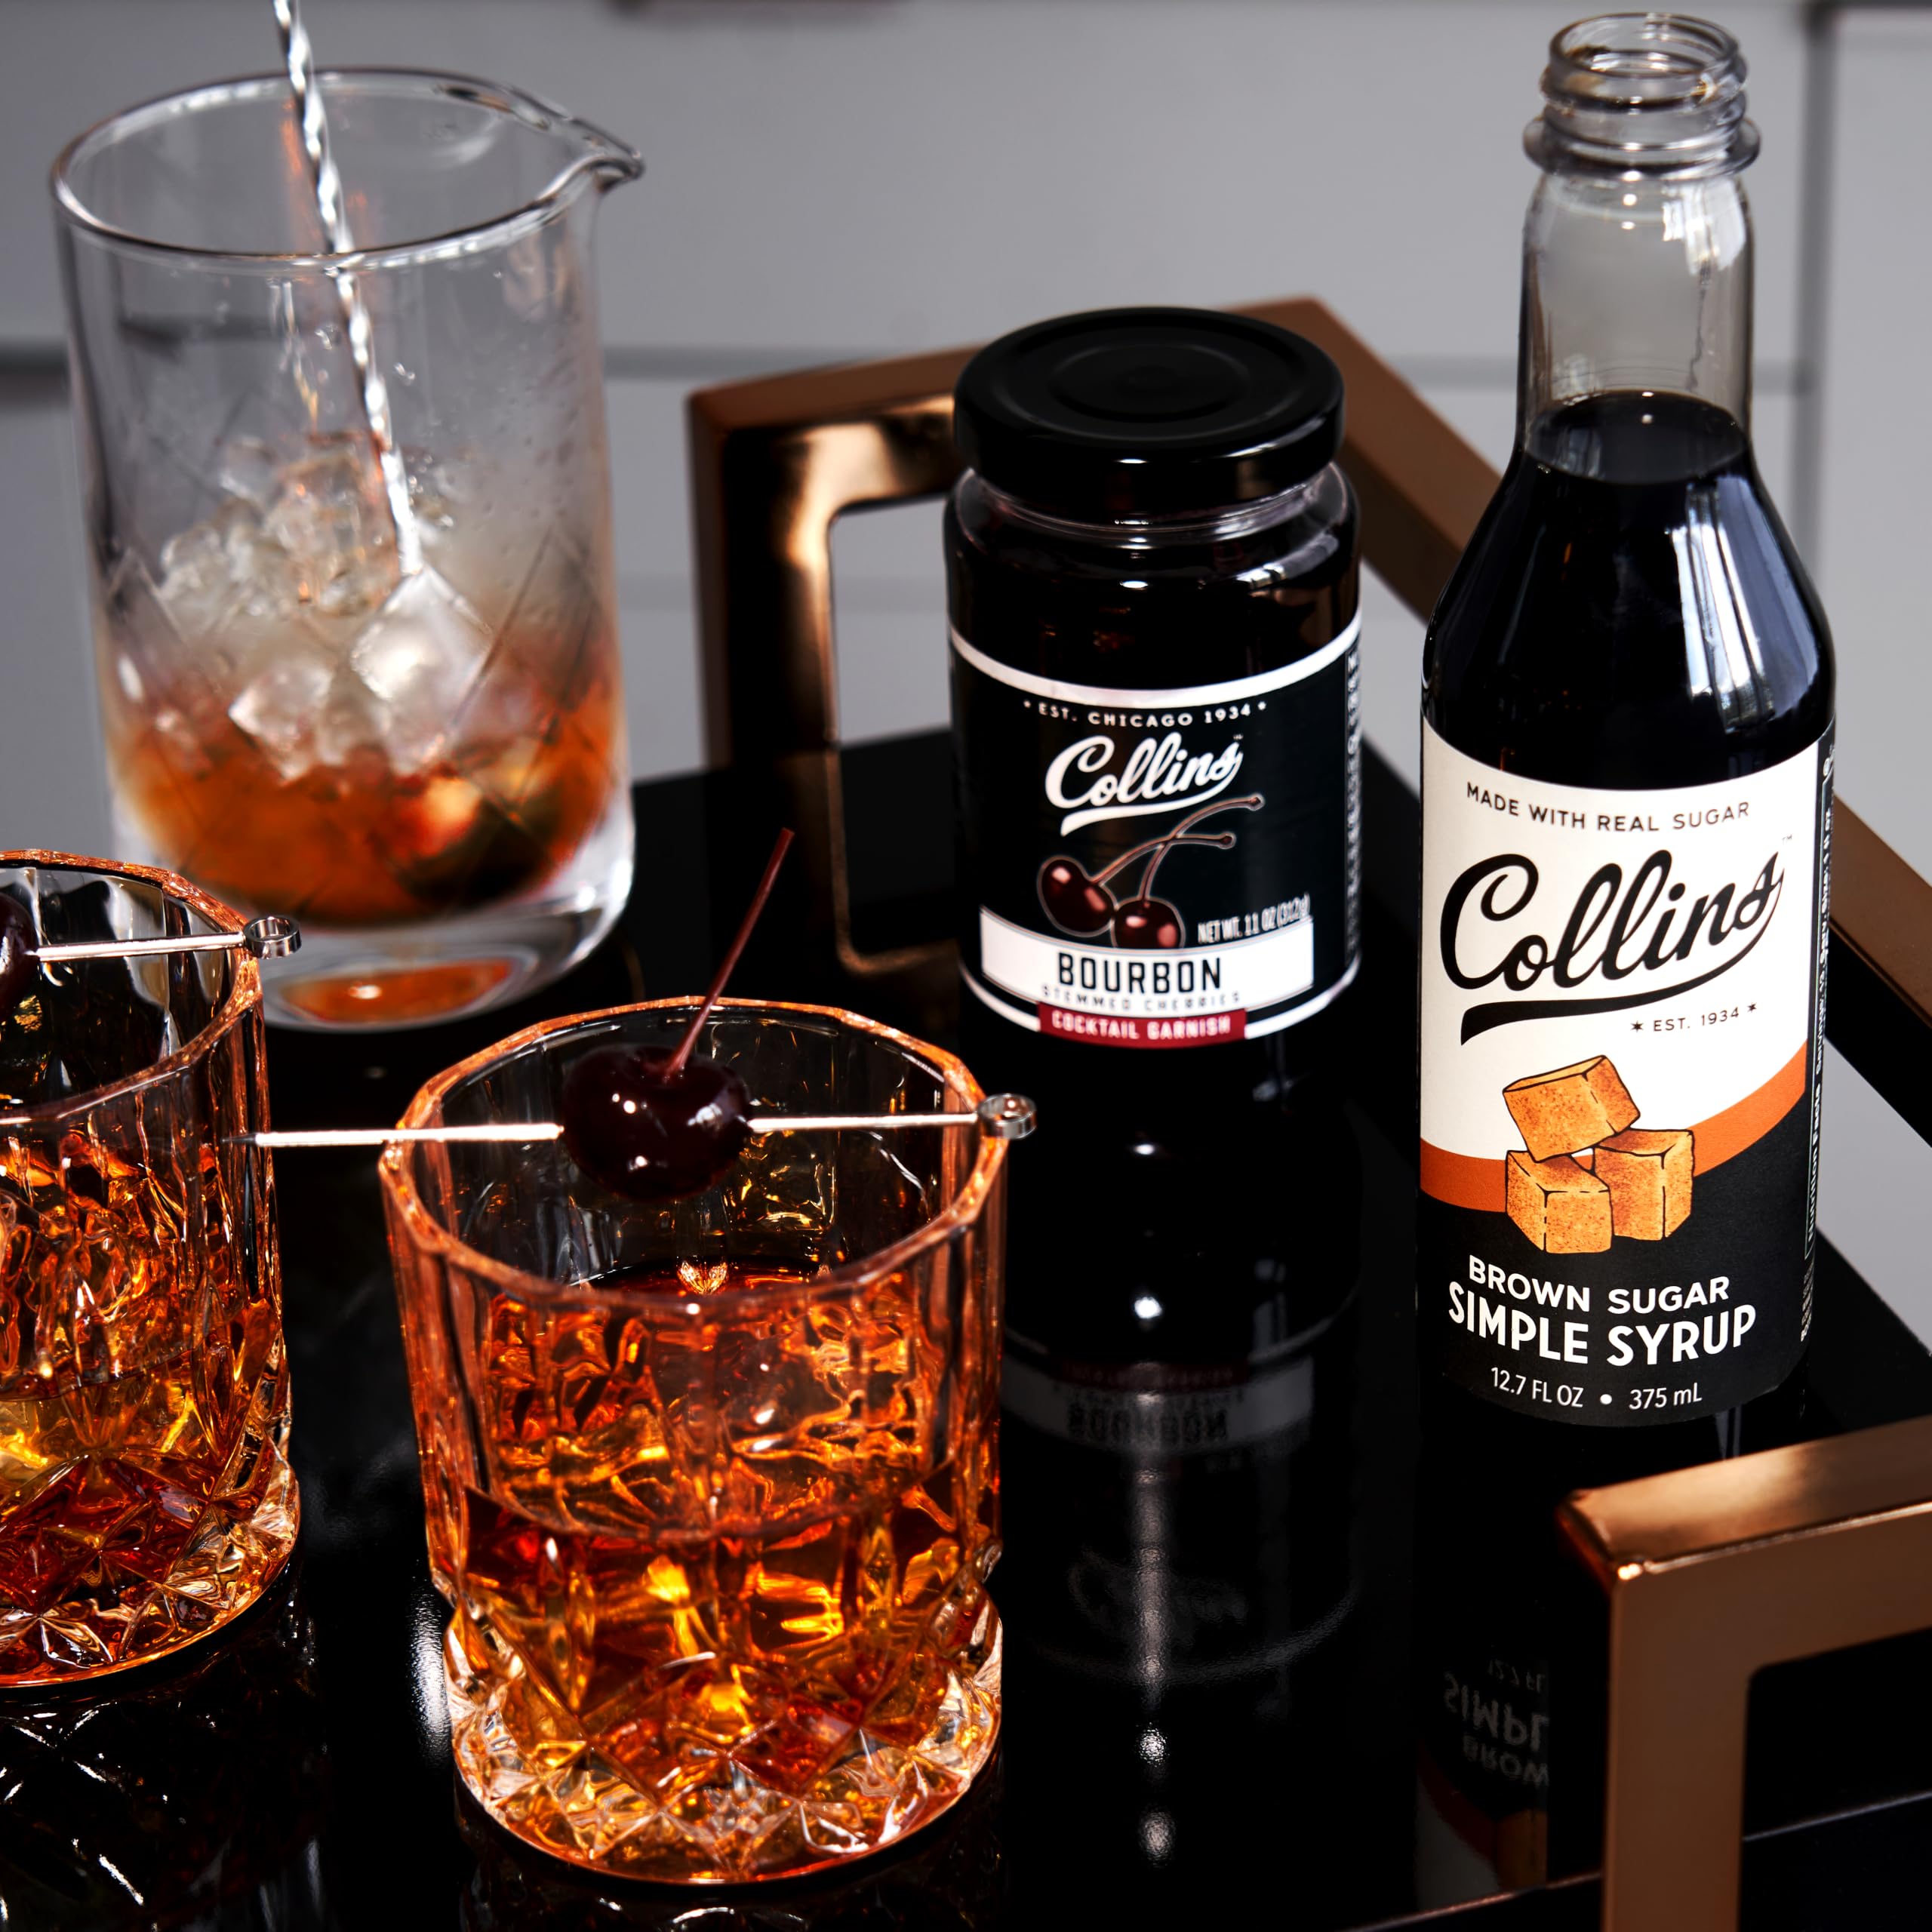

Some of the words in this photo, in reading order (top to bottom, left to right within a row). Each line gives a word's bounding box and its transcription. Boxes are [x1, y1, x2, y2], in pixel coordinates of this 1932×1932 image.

[1038, 702, 1077, 721] EST.
[1088, 712, 1193, 728] CHICAGO
[1204, 703, 1251, 724] 1934
[1044, 732, 1243, 837] Collins
[1466, 780, 1520, 817] MADE
[1528, 802, 1586, 829] WITH
[1597, 814, 1660, 832] REAL
[1672, 801, 1750, 830] SUGAR
[1198, 920, 1220, 943] NET
[1222, 916, 1243, 940] WT.
[1244, 912, 1260, 936] 11
[1261, 906, 1276, 931] OZ
[1440, 850, 1786, 1046] Collins
[1058, 952, 1220, 994] BOURBON
[1041, 984, 1131, 1011] STEMMED
[1143, 991, 1240, 1011] CHERRIES
[1653, 1018, 1691, 1032] EST.
[1700, 1005, 1740, 1026] 1934
[1051, 1010, 1140, 1040] COCKTAIL
[1146, 1014, 1232, 1041] GARNISH
[1808, 1146, 1818, 1242] Nutrition
[1813, 1083, 1821, 1146] Facts
[1469, 1254, 1590, 1312] BROWN
[1607, 1275, 1730, 1315] SUGAR
[1448, 1281, 1589, 1364] SIMPLE
[1607, 1304, 1757, 1367] SYRUP
[1491, 1367, 1527, 1395] 12.7
[1532, 1380, 1552, 1403] FL
[1557, 1383, 1583, 1407] OZ
[1629, 1387, 1667, 1410] 375
[1673, 1383, 1703, 1404] mL
